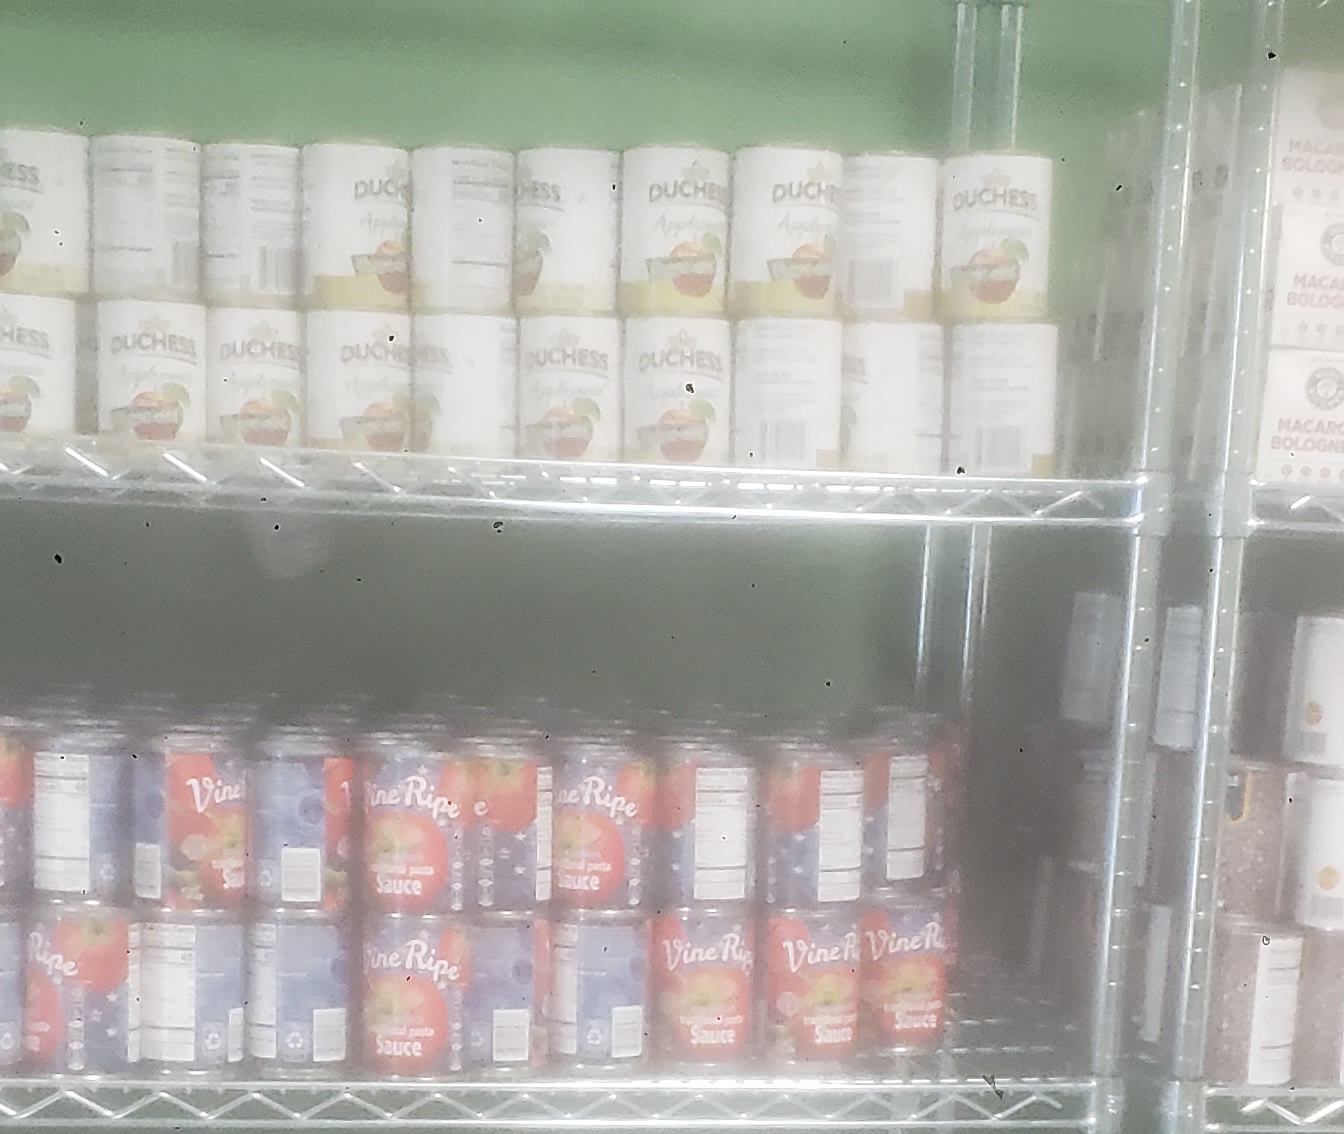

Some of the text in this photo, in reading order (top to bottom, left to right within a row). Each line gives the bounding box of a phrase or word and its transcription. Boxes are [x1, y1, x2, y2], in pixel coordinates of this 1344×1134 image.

[354, 178, 410, 200] DUCH
[648, 178, 728, 203] DUCHE
[771, 179, 840, 203] DUCH
[953, 187, 1038, 212] DUCHESS
[110, 332, 197, 358] DUCHESS
[524, 346, 609, 371] DUCHESS
[638, 346, 724, 373] DUCHESS
[403, 775, 461, 819] Ripe
[582, 775, 639, 820] Ripe
[376, 872, 423, 896] Sauce
[27, 929, 79, 979] Ripe
[662, 932, 753, 978] Vine Rip
[782, 938, 843, 974] Vine
[865, 928, 923, 961] Vine
[404, 938, 460, 982] Ripe
[894, 1011, 937, 1029] Sauce
[375, 1033, 423, 1057] Sauce
[690, 1024, 736, 1046] Sauce
